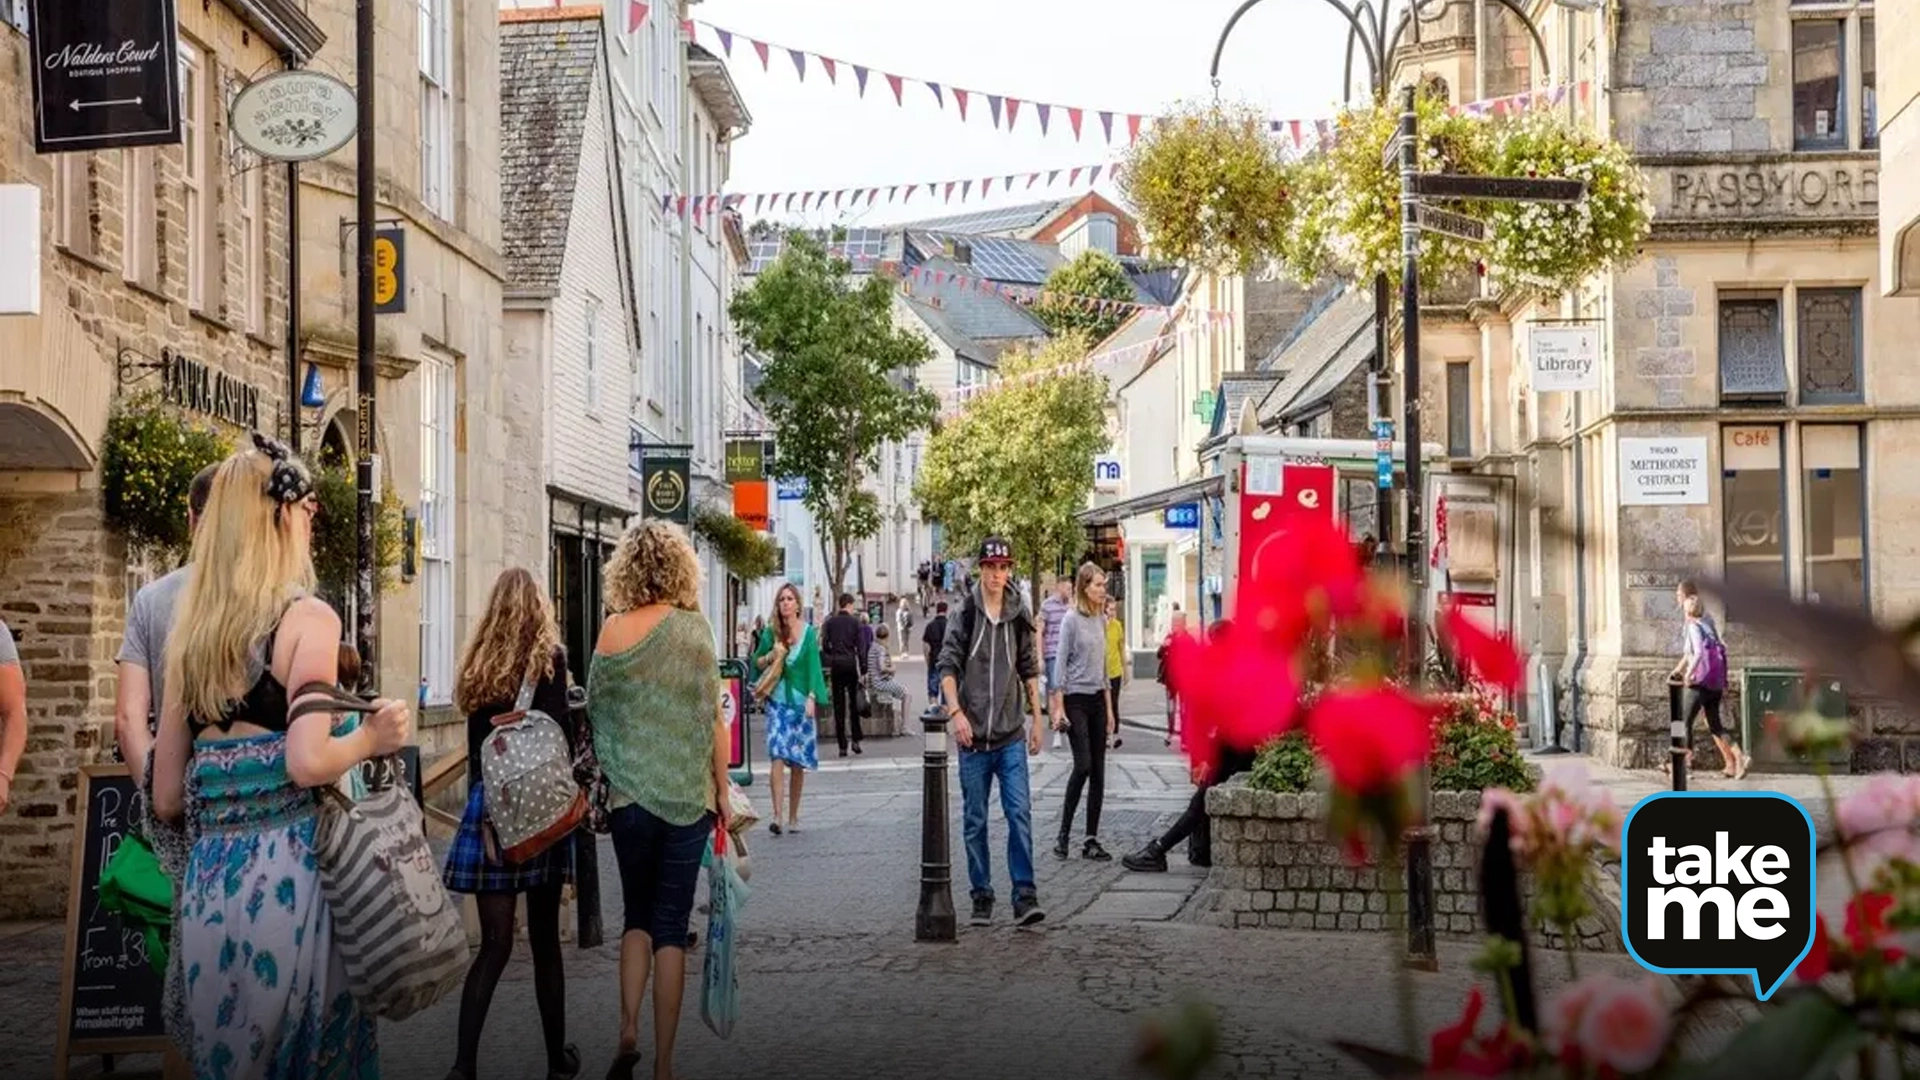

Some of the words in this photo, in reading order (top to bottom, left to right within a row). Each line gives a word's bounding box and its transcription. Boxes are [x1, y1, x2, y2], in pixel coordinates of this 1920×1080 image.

[45, 43, 116, 69] Nalders
[116, 40, 160, 64] Court
[69, 67, 104, 78] BOUTIQUE
[106, 65, 142, 76] SHOPPING
[1672, 168, 1879, 210] PASSMORE
[1537, 356, 1592, 374] Library
[1733, 430, 1770, 446] Café
[1630, 458, 1698, 471] METHODIST
[1637, 474, 1690, 486] CHURCH
